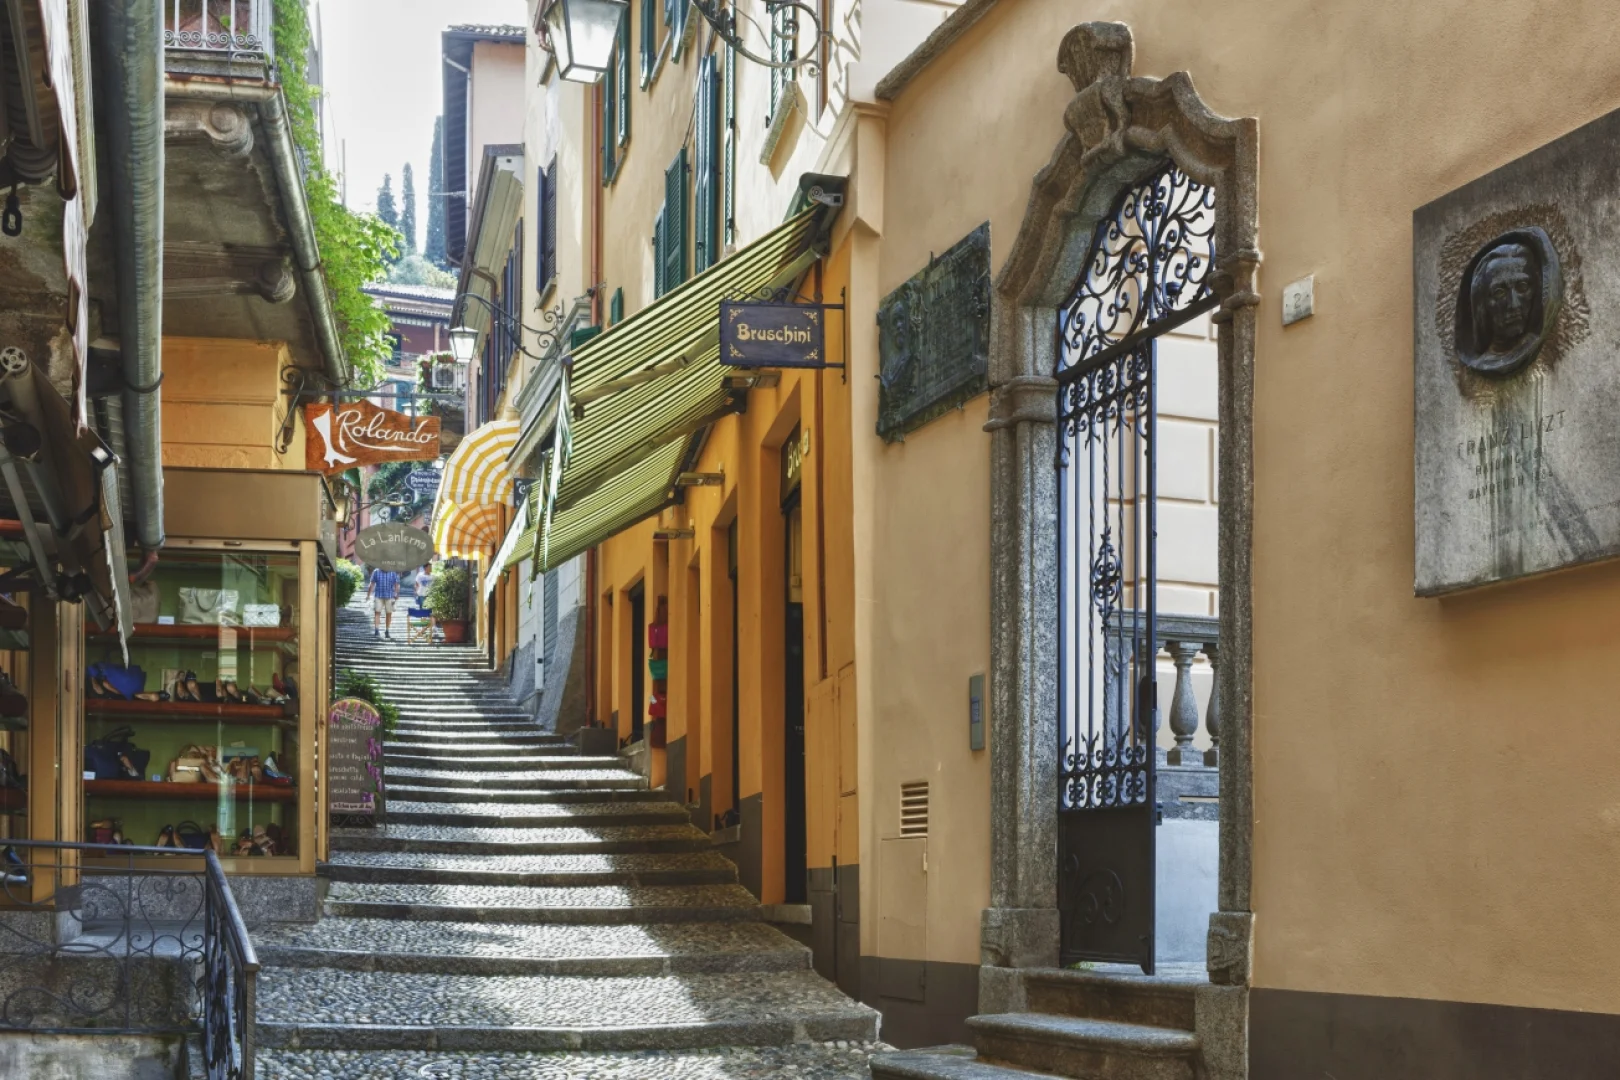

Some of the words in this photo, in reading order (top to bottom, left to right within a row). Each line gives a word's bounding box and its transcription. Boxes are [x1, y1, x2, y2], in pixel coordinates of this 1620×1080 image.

[1293, 292, 1302, 310] 2
[737, 323, 811, 345] Bruschini
[335, 410, 438, 453] Rolando
[1520, 409, 1566, 440] LIZT
[360, 537, 376, 549] La
[377, 529, 427, 550] Lanterna
